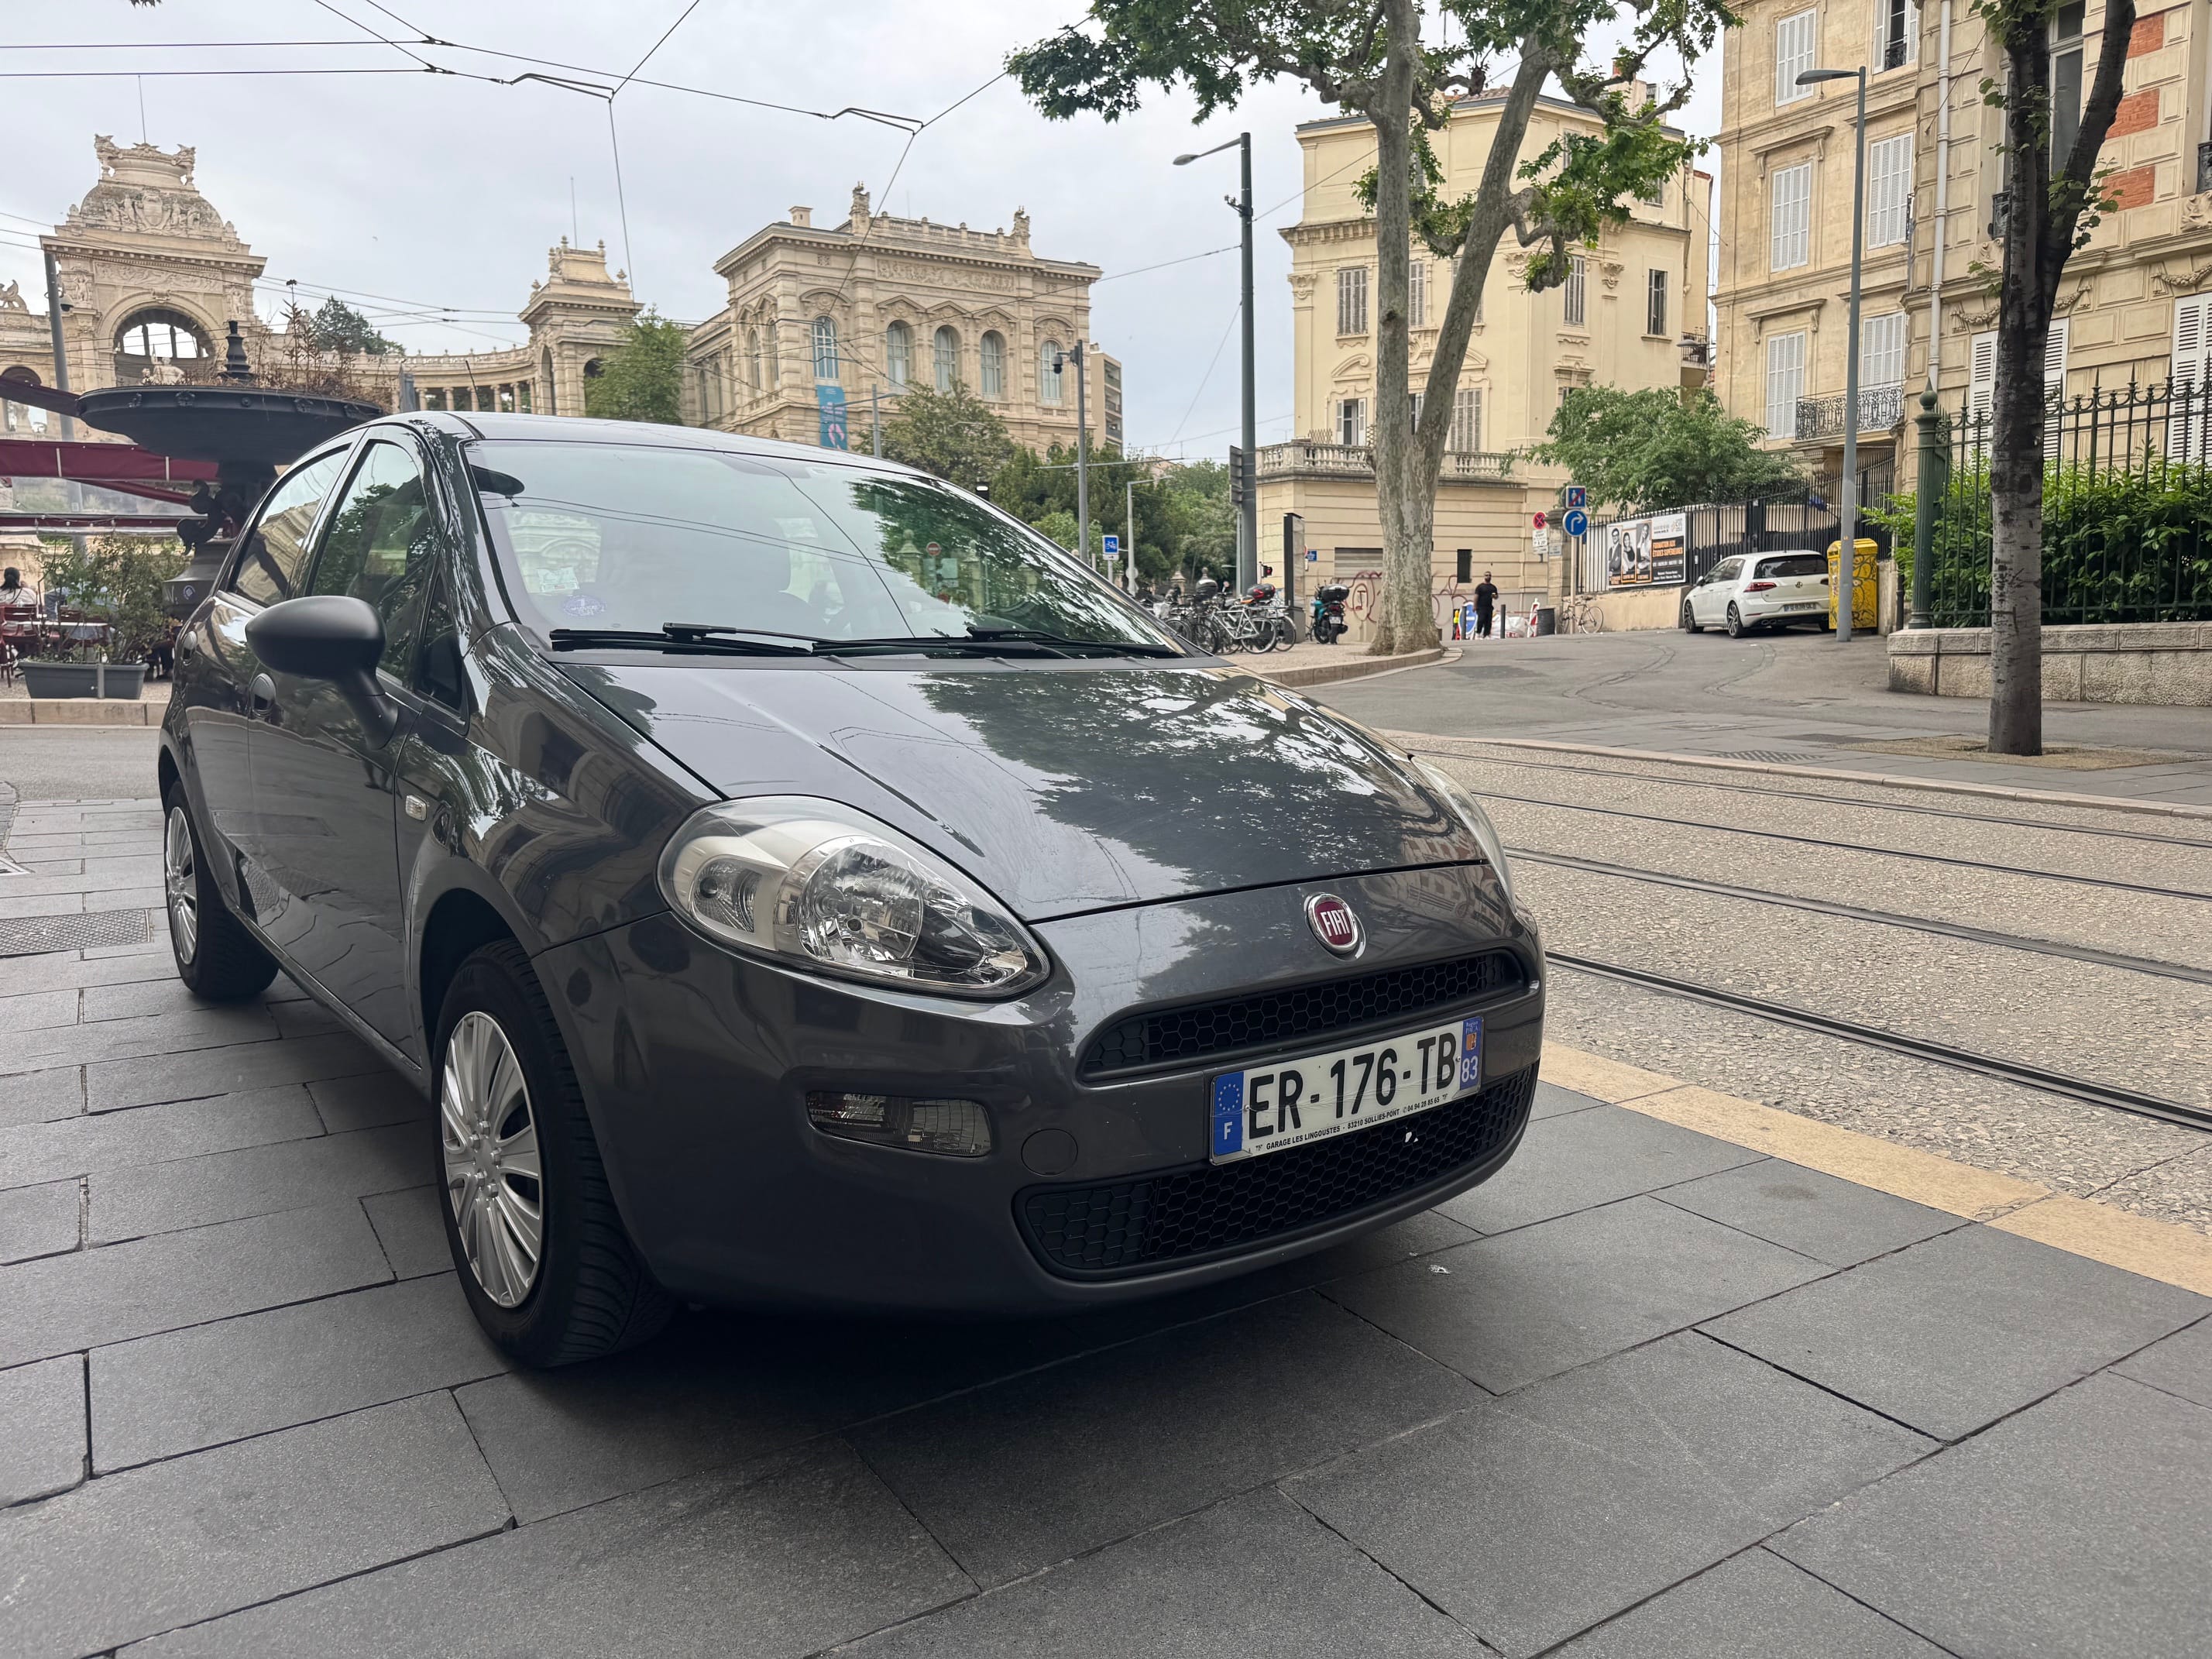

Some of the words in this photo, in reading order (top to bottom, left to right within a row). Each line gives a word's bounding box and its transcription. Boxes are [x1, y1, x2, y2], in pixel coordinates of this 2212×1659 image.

[1320, 909, 1351, 937] FIAT
[1462, 1056, 1479, 1083] 83
[1249, 1032, 1457, 1139] ER-176-TB
[1224, 1121, 1233, 1140] F
[1266, 1138, 1291, 1150] GARAGE
[1293, 1135, 1304, 1143] LES
[1304, 1125, 1341, 1140] LINGOUSTES
[1348, 1119, 1363, 1129] 83210
